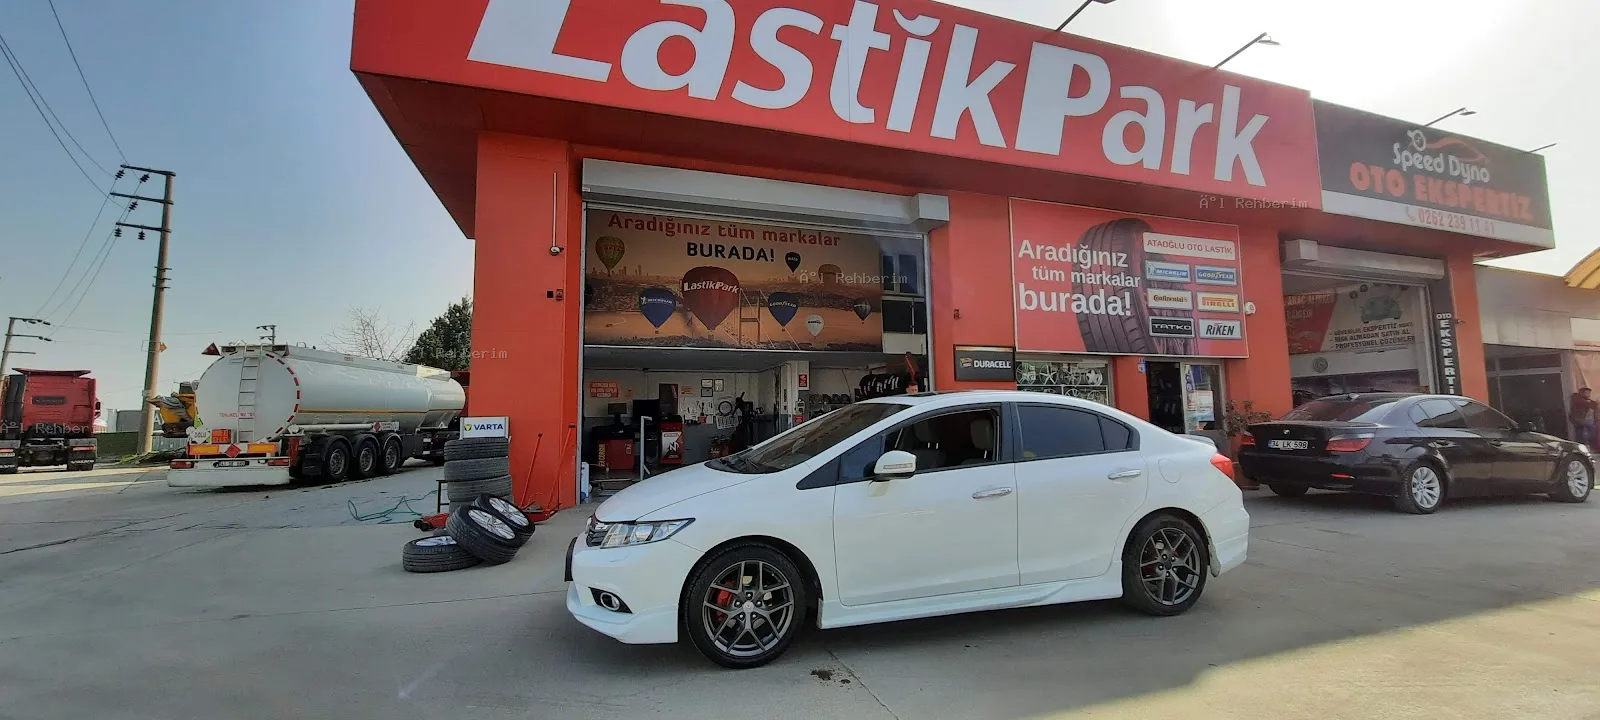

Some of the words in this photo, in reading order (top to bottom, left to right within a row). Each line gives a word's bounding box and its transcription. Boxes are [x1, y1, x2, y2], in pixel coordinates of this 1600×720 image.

[1393, 142, 1445, 172] Speed
[1448, 154, 1491, 185] Dyno
[1350, 161, 1406, 197] OTO
[608, 212, 712, 237] Aradığınız
[718, 225, 756, 240] tüm
[762, 230, 841, 247] markalar
[1418, 207, 1445, 227] 0262
[1448, 211, 1466, 231] 239
[686, 241, 775, 263] BURADA!
[1018, 239, 1129, 269] Aradığınız
[1187, 243, 1203, 252] OTO
[1031, 265, 1065, 282] tüm
[1071, 270, 1141, 288] markalar
[1155, 268, 1189, 277] MICHELIN
[683, 280, 740, 294] LastikPark
[1018, 282, 1131, 317] burada!
[1202, 297, 1235, 308] PIRELLI
[973, 360, 1012, 369] DURACELL
[473, 423, 504, 431] VARTA
[1293, 441, 1308, 449] 598
